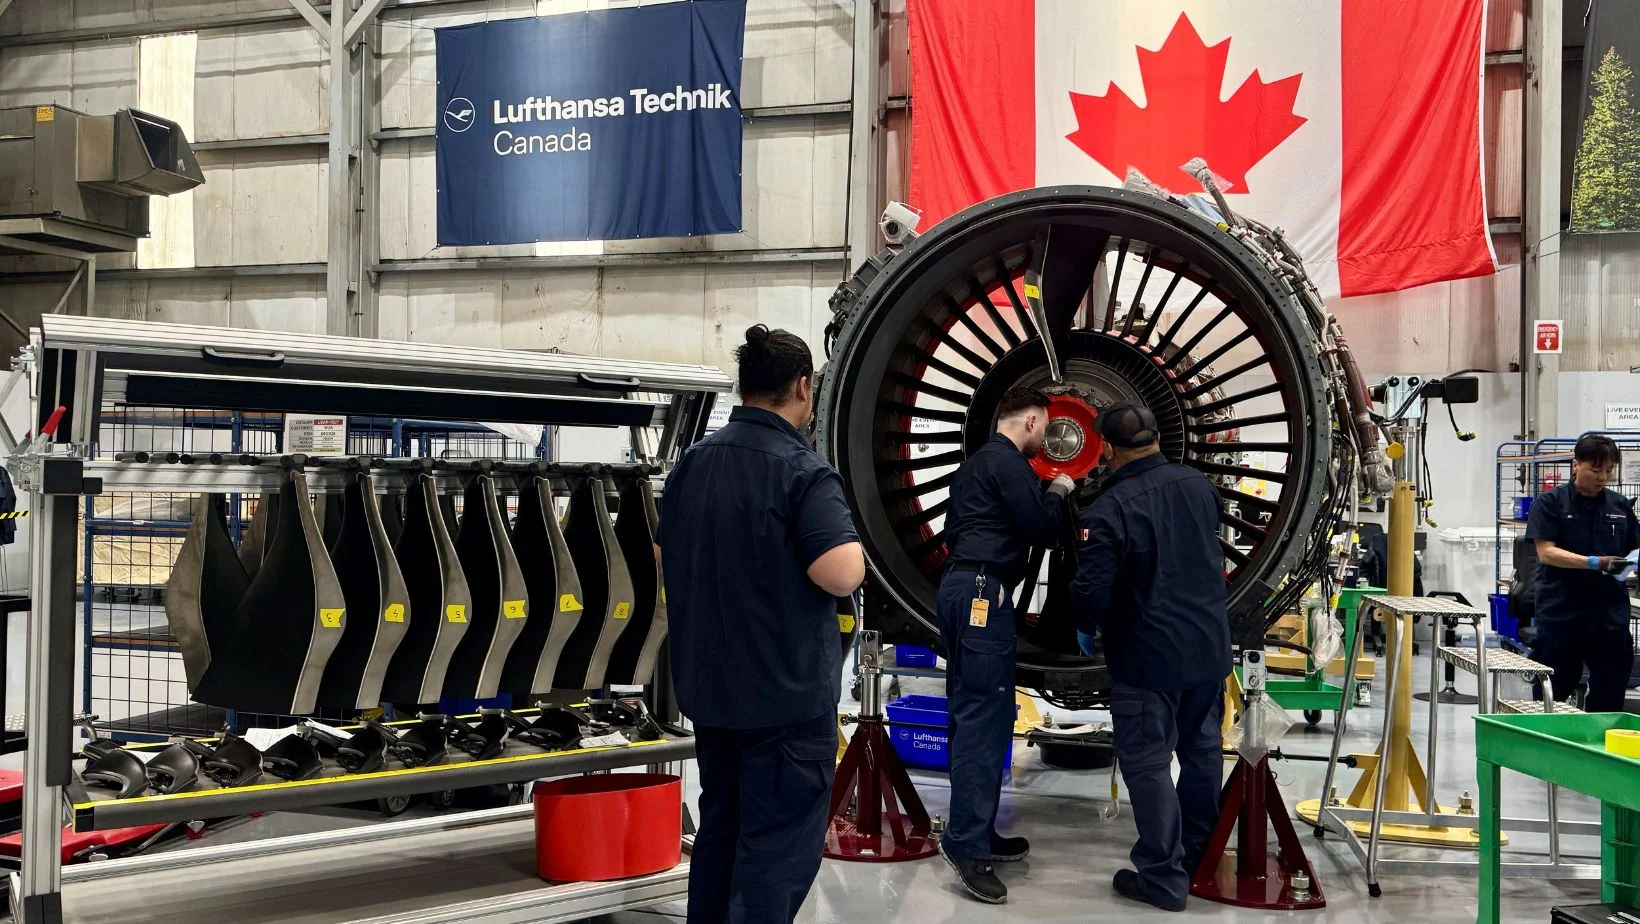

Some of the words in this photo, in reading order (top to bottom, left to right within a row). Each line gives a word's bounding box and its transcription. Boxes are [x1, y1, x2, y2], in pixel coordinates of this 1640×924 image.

[493, 95, 625, 124] Lufthansa
[629, 83, 732, 115] Technik
[493, 126, 591, 156] Canada
[326, 612, 333, 623] 3
[393, 608, 399, 618] 4
[455, 610, 461, 619] 5
[912, 740, 941, 751] Canada
